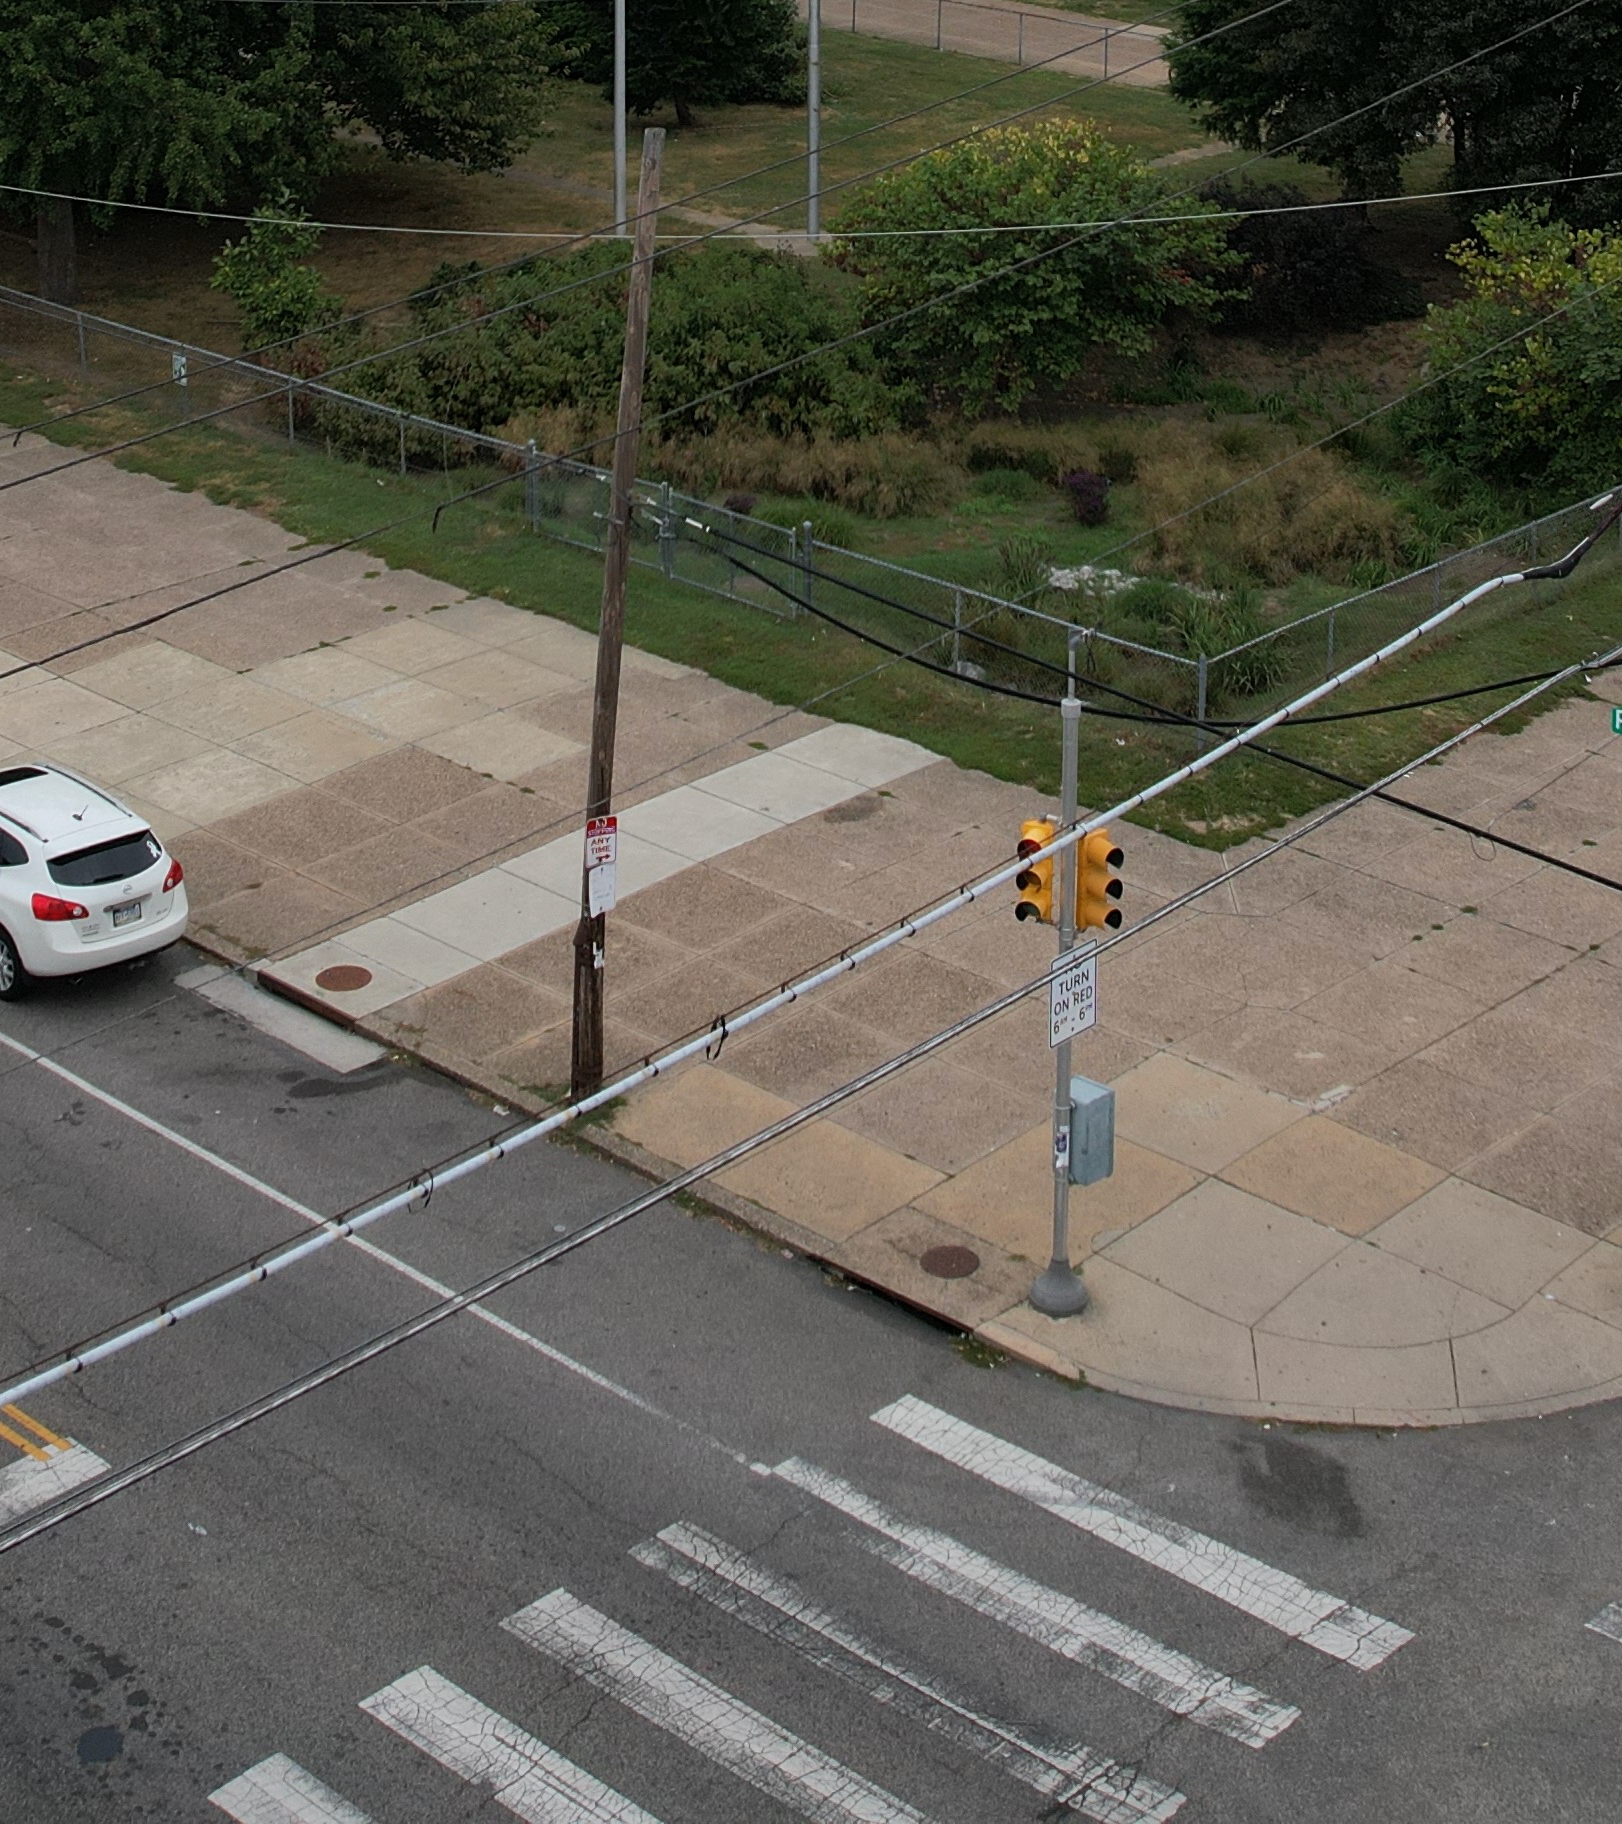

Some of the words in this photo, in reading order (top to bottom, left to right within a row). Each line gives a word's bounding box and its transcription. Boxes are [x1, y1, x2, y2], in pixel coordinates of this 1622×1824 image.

[591, 836, 611, 847] ANY
[591, 845, 611, 856] TIME
[1059, 968, 1089, 995] TURN
[1054, 997, 1070, 1016] ON
[1073, 985, 1093, 1006] RED
